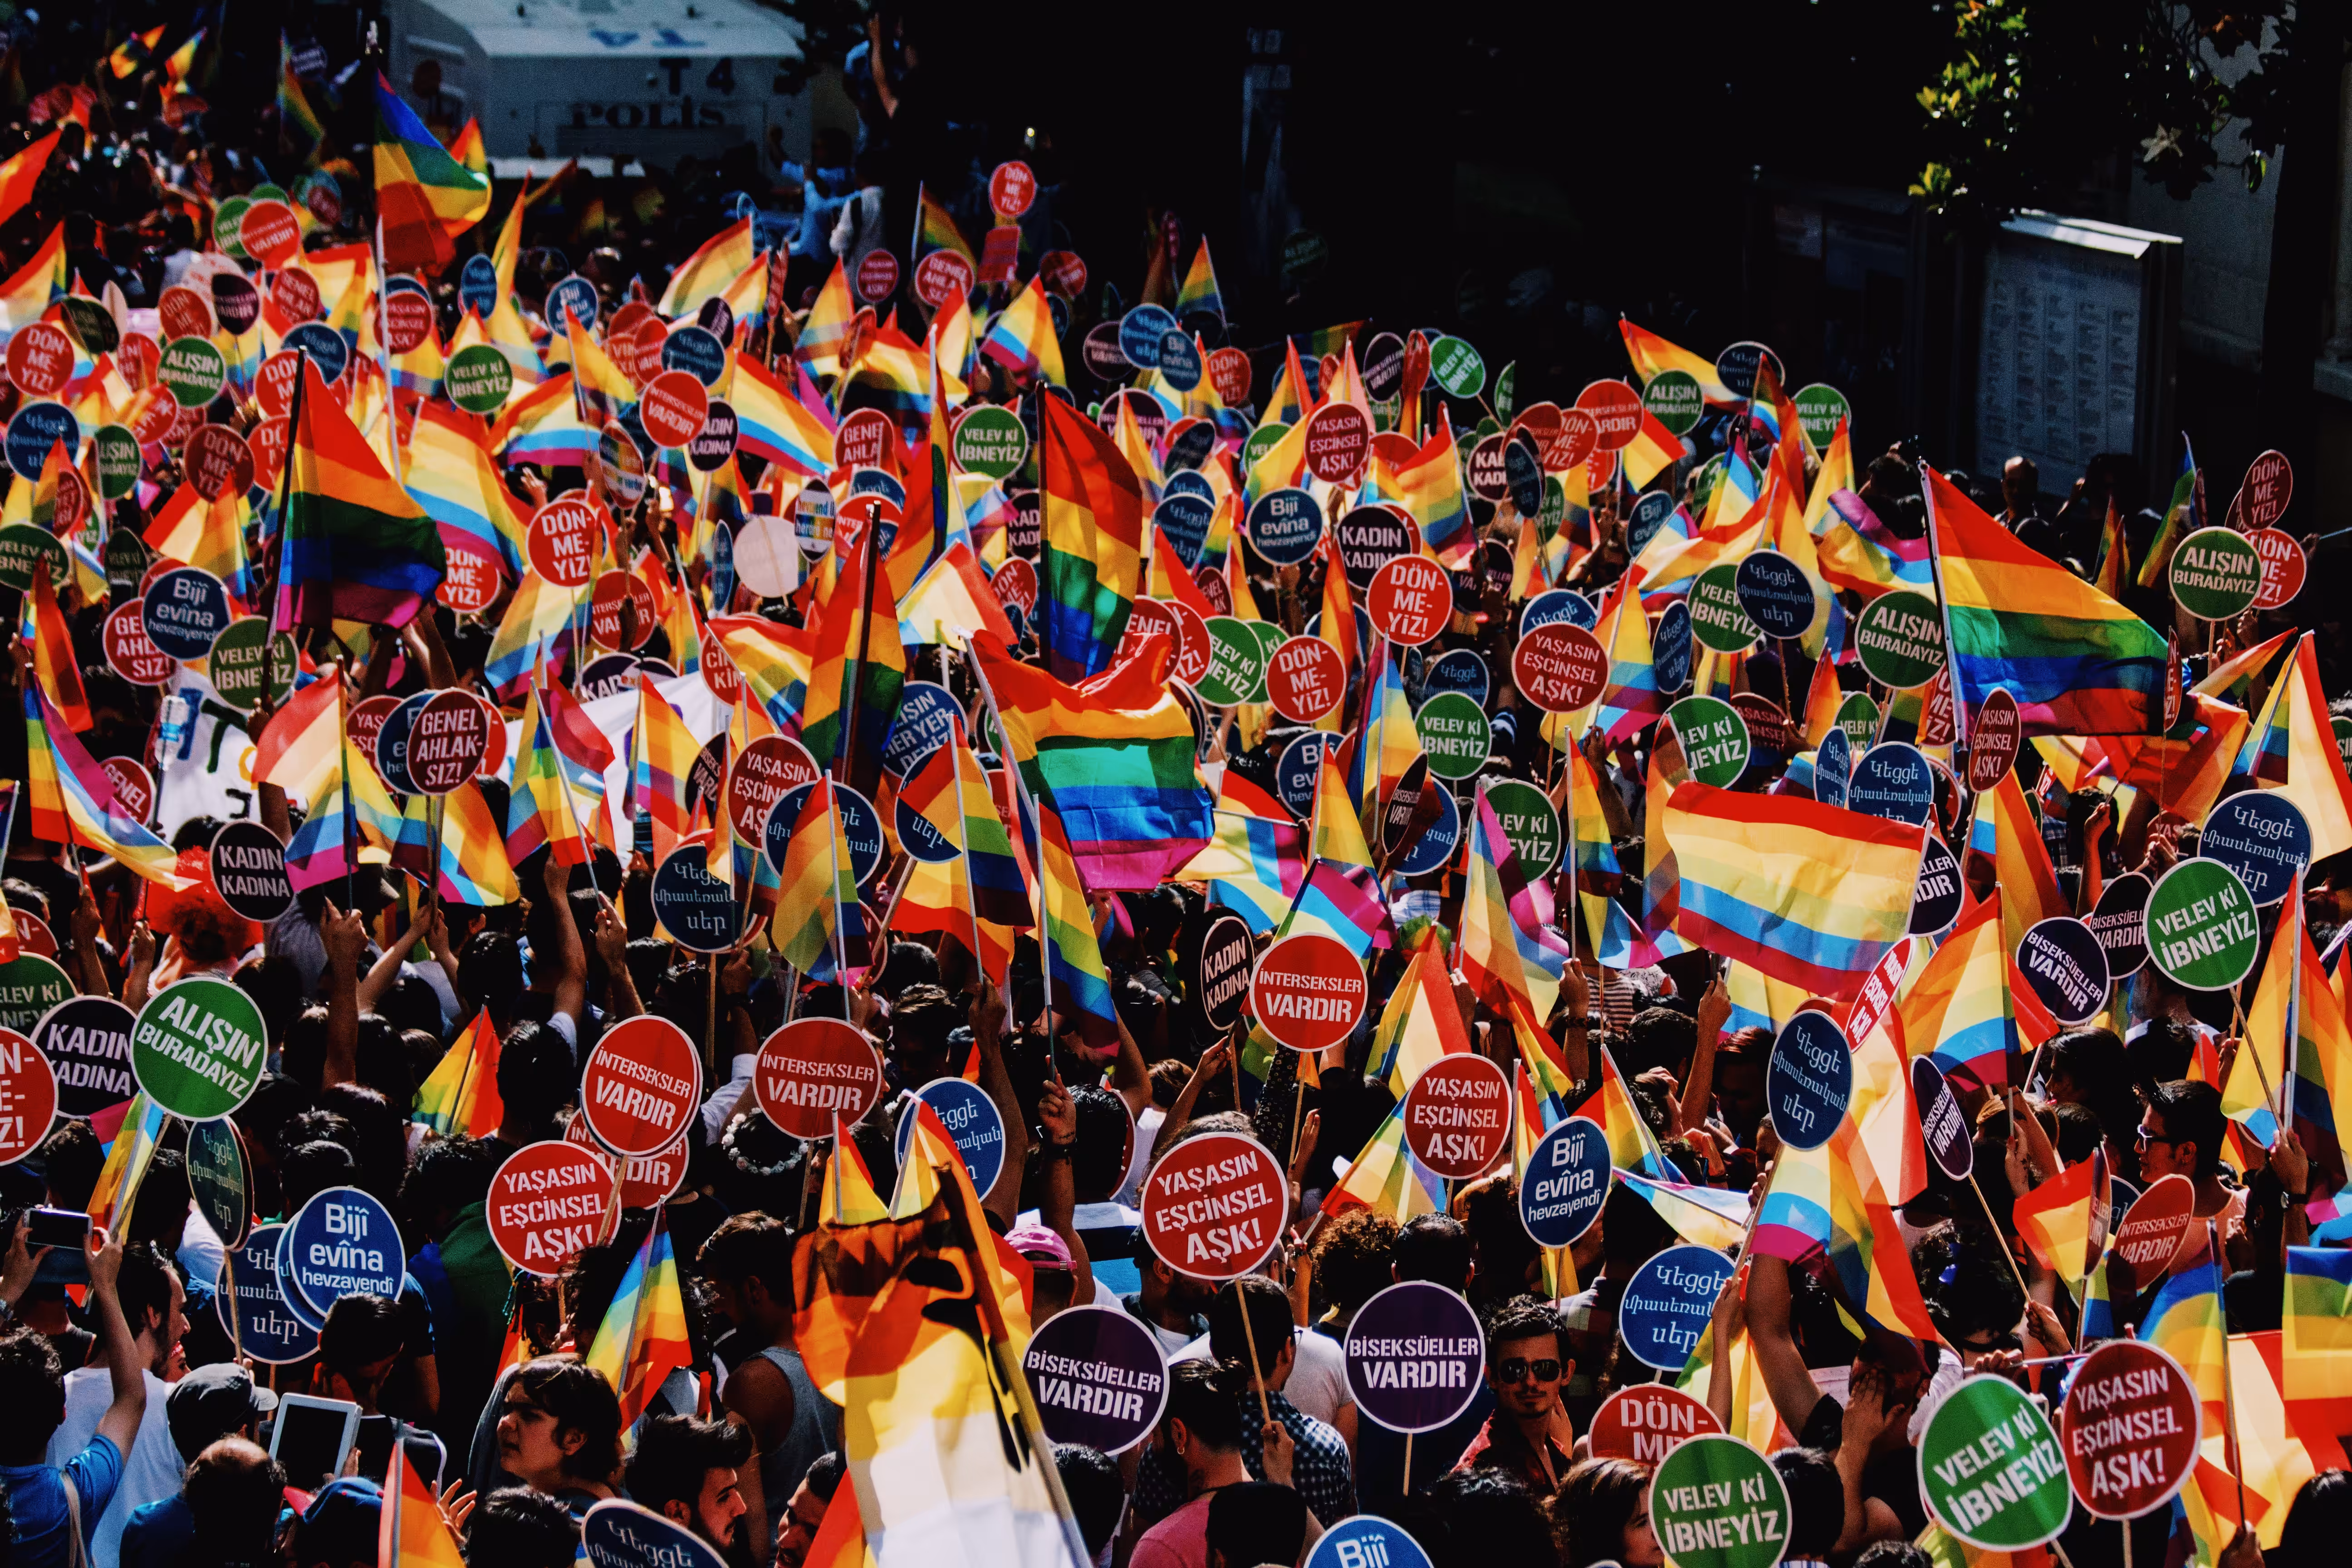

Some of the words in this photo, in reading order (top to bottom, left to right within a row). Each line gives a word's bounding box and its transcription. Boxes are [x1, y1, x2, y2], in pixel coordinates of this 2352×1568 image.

[659, 58, 691, 95] T
[706, 58, 736, 95] 4
[1650, 383, 1697, 402] ALIŞIN
[964, 427, 1002, 442] VELEV
[1005, 428, 1017, 442] Kİ
[1314, 415, 1361, 433] YAŞASIN
[100, 443, 136, 459] LIŞIN
[959, 442, 1020, 462] İBNEYİZ
[1319, 454, 1354, 474] AŞK!
[1475, 451, 1504, 468] KAD
[2252, 456, 2286, 483] DÖN-
[2254, 481, 2279, 502] ME-
[542, 509, 592, 535] DÖN-
[1260, 517, 1309, 536] evîna
[1342, 526, 1401, 548] KADIN
[552, 535, 589, 555] ME-
[1343, 549, 1389, 568] KADIN
[2182, 546, 2254, 577] ALIŞIN
[172, 578, 207, 604] Bijî
[1390, 564, 1443, 591] DÖN-
[2173, 569, 2256, 595] BURADAYIZ
[156, 603, 215, 627] evîna
[1394, 590, 1432, 611] ME-
[1387, 610, 1427, 638] YİZ!
[1871, 605, 1943, 642] ALIŞIN
[1279, 644, 1329, 673] DÖN-
[1534, 632, 1600, 662] YAŞASIN
[1859, 630, 1944, 667] BURADAYIZ
[1240, 657, 1257, 676] Kİ
[1290, 671, 1326, 692] ME-
[1523, 653, 1598, 684] EŞCİNSEL
[1292, 690, 1331, 715] YİZ!
[1529, 681, 1582, 705] AŞK!
[421, 709, 479, 735] GENEL
[1424, 717, 1465, 732] VELEV
[1468, 715, 1481, 732] Kİ
[1713, 716, 1732, 738] Kİ
[1982, 710, 2015, 727] YAŞASIN
[416, 734, 483, 763] AHLAK-
[425, 762, 462, 785] SIZ!
[746, 752, 811, 783] YAŞASIN
[1973, 756, 2001, 781] AŞK!
[734, 775, 788, 805] EŞCİN
[1530, 813, 1548, 834] Kİ
[219, 845, 284, 871] KADIN
[220, 875, 290, 897] KADINA
[2092, 909, 2144, 930] BİSEKSÜELL
[2155, 896, 2217, 936] VELEV
[2222, 882, 2239, 910] Kİ
[2161, 910, 2256, 971] İBNEYİZ
[1204, 936, 1246, 978] KADIN
[2026, 931, 2103, 1002] BİSEKSÜELLER
[1205, 967, 1250, 1013] KADINA
[1259, 968, 1362, 994] İNTERSEKSLER
[2028, 949, 2089, 1013] VARDIR
[1265, 991, 1352, 1023] VARDIR
[47, 1023, 131, 1063] KADIN
[158, 996, 261, 1069] ALIŞIN
[136, 1022, 250, 1100] BURADAYIZ
[595, 1046, 691, 1099] İNTERSEKSLER
[762, 1051, 875, 1082] İNTERSEKSLER
[595, 1076, 676, 1130] VARDIR
[767, 1077, 862, 1111] VARDIR
[1425, 1077, 1500, 1101] YAŞASIN
[1413, 1103, 1499, 1129] EŞCİNSEL
[1933, 1103, 1962, 1156] VARDIR
[1426, 1133, 1485, 1165] AŞK!
[1552, 1132, 1586, 1167] Bijî
[503, 1163, 597, 1194] YAŞASIN
[1156, 1151, 1258, 1196] YAŞASIN
[1535, 1169, 1594, 1202] evîna
[500, 1193, 606, 1229] EŞCİNSEL
[1155, 1182, 1273, 1233] EŞCİNSEL
[1528, 1189, 1601, 1223] hevzayendî
[325, 1202, 369, 1241] Bijî
[2119, 1212, 2189, 1237] İNTERSEKSLER
[1186, 1218, 1264, 1264] AŞK!
[309, 1240, 383, 1273] evîna
[302, 1268, 394, 1295] hevzayendî
[1349, 1337, 1479, 1357] BİSEKSÜELLER
[1027, 1349, 1162, 1393] BİSEKSÜELLER
[1362, 1360, 1467, 1389] VARDIR
[1038, 1375, 1144, 1423] VARDIR
[2075, 1366, 2169, 1415] YAŞASIN
[1621, 1396, 1708, 1433] DÖN-
[1933, 1419, 2015, 1487] VELEV
[2013, 1402, 2038, 1441] Kİ
[2072, 1406, 2183, 1458] EŞCİNSEL
[1946, 1439, 2064, 1534] İBNEYİZ
[2091, 1447, 2166, 1499] AŞK!
[1662, 1481, 1731, 1513] VELEV
[1741, 1472, 1766, 1503] Kİ
[1664, 1506, 1783, 1554] İBNEYİZ
